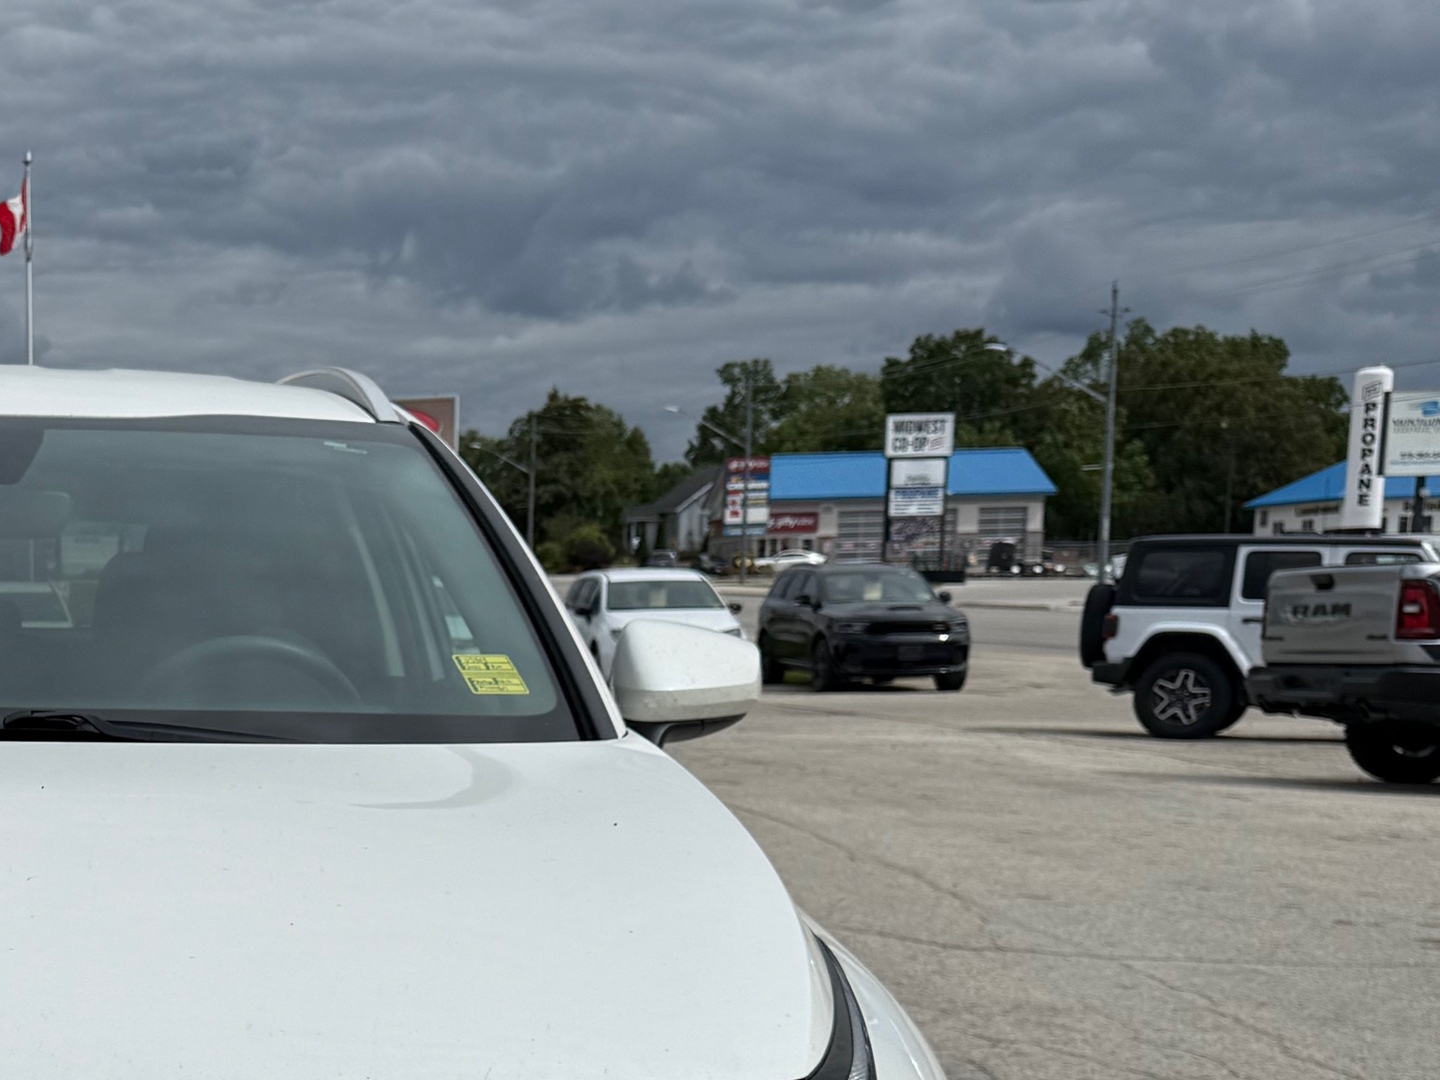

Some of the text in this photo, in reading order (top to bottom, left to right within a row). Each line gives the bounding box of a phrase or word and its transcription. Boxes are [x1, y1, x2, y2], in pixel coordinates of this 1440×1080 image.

[892, 419, 946, 435] MIDWEST
[892, 436, 929, 452] CO-OP
[1357, 402, 1378, 507] PROPANE
[1292, 603, 1353, 618] RAM
